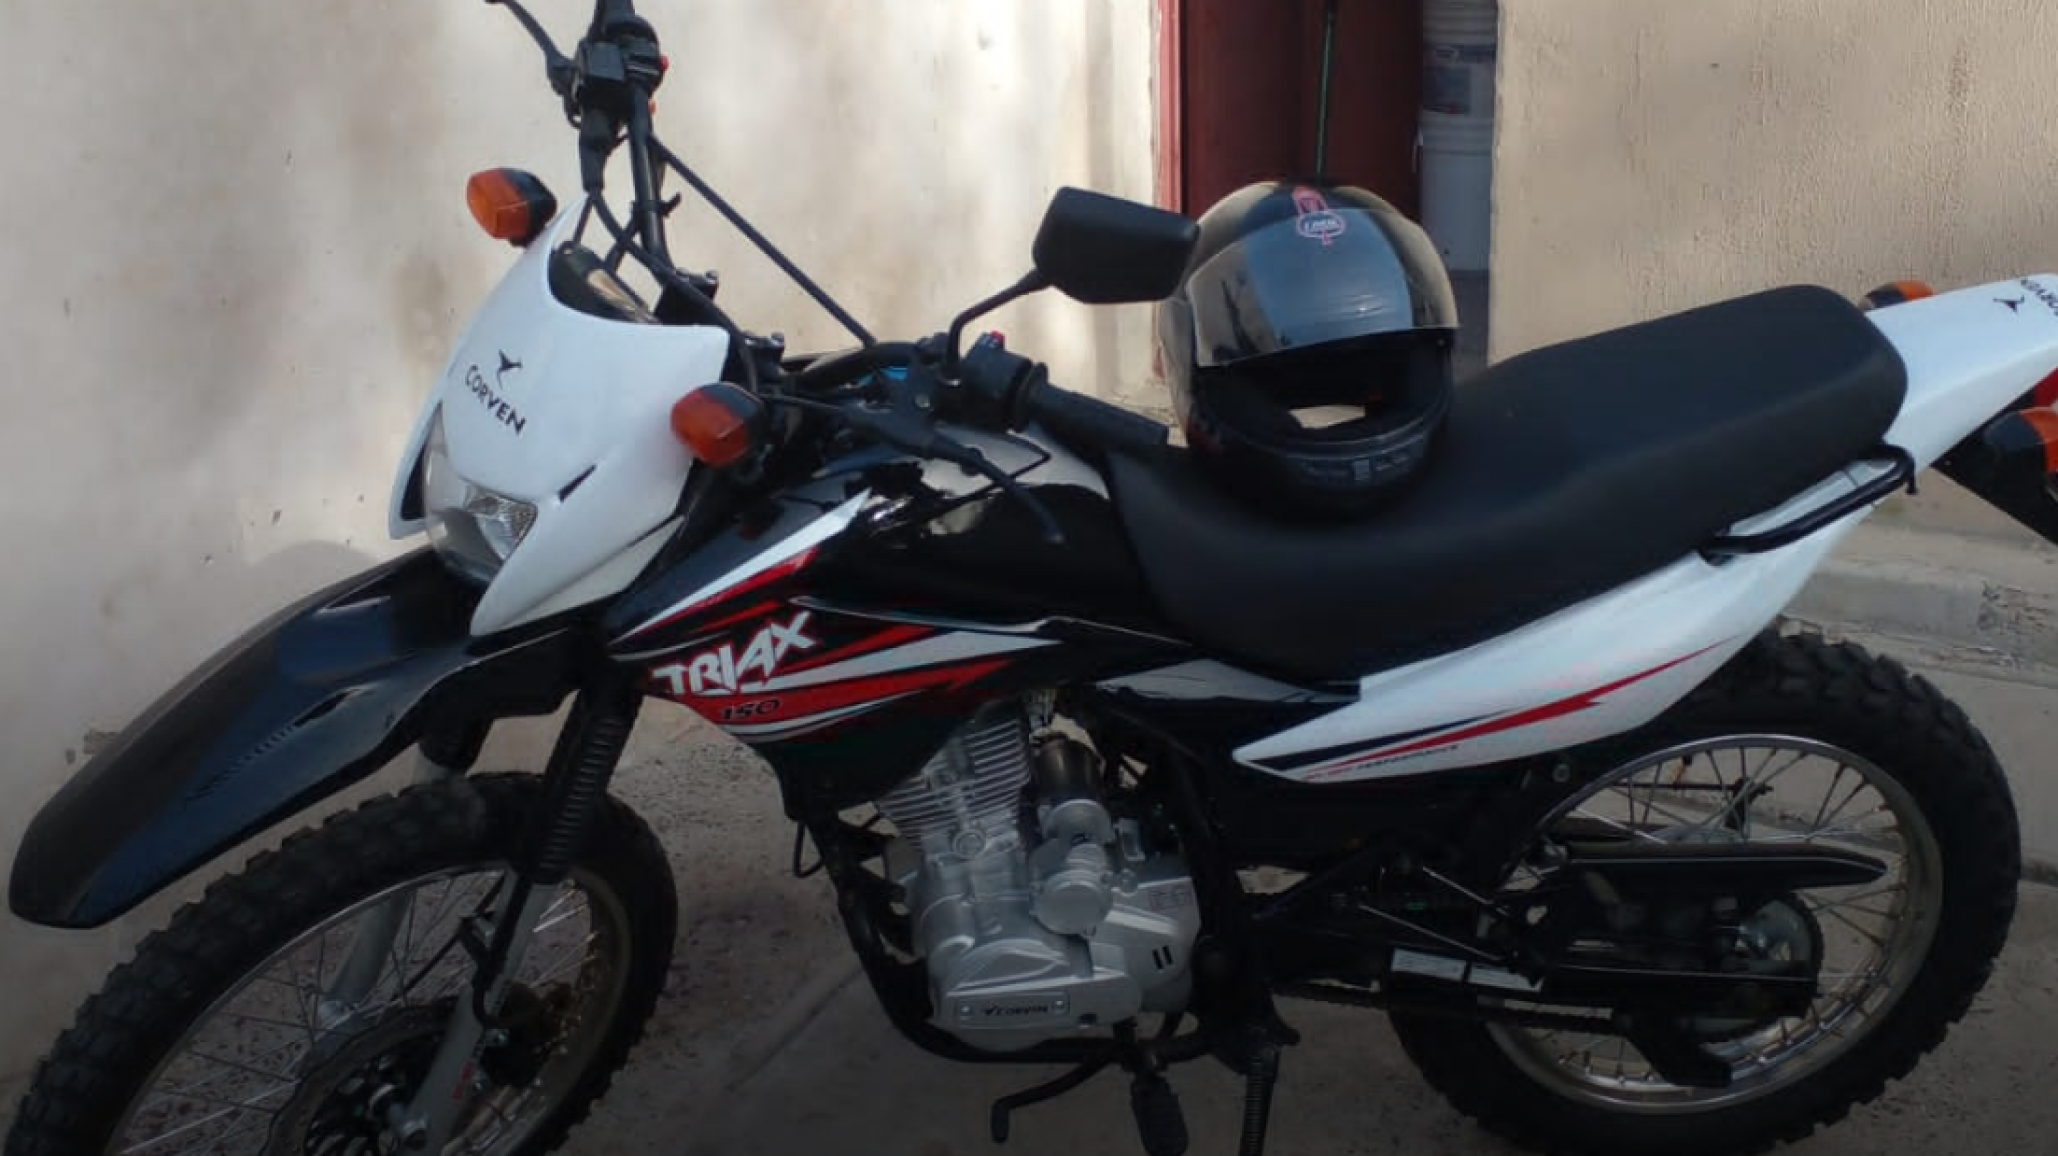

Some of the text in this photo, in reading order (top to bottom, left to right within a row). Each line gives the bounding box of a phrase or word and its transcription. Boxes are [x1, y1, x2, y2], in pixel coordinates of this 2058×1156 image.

[465, 364, 526, 436] CORVEN
[652, 610, 816, 696] TRIAX
[723, 698, 782, 721] 150
